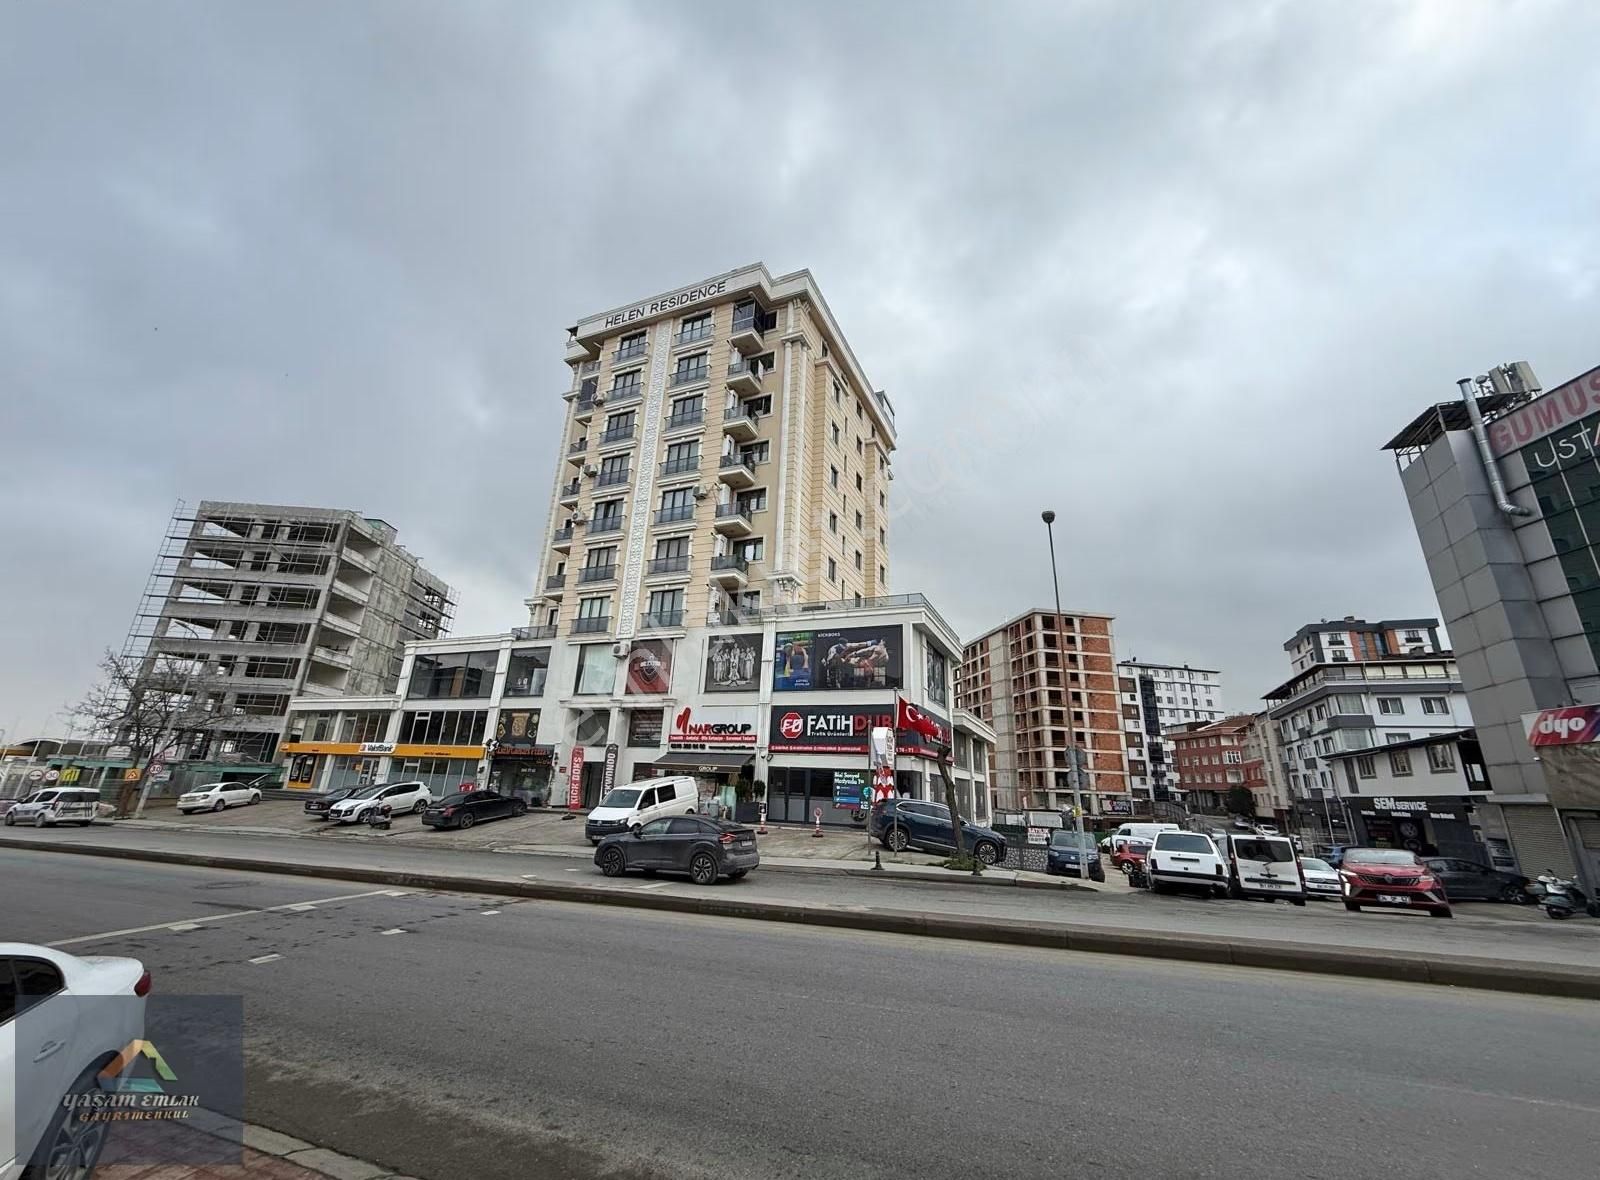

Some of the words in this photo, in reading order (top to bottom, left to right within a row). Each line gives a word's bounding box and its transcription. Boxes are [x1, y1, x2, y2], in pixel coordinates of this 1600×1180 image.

[605, 307, 645, 328] HELEN
[650, 281, 726, 314] RESIDENCE
[1535, 422, 1600, 468] UST
[1538, 714, 1586, 739] dyo
[1373, 797, 1395, 810] SEM
[1396, 801, 1428, 811] SERVICE
